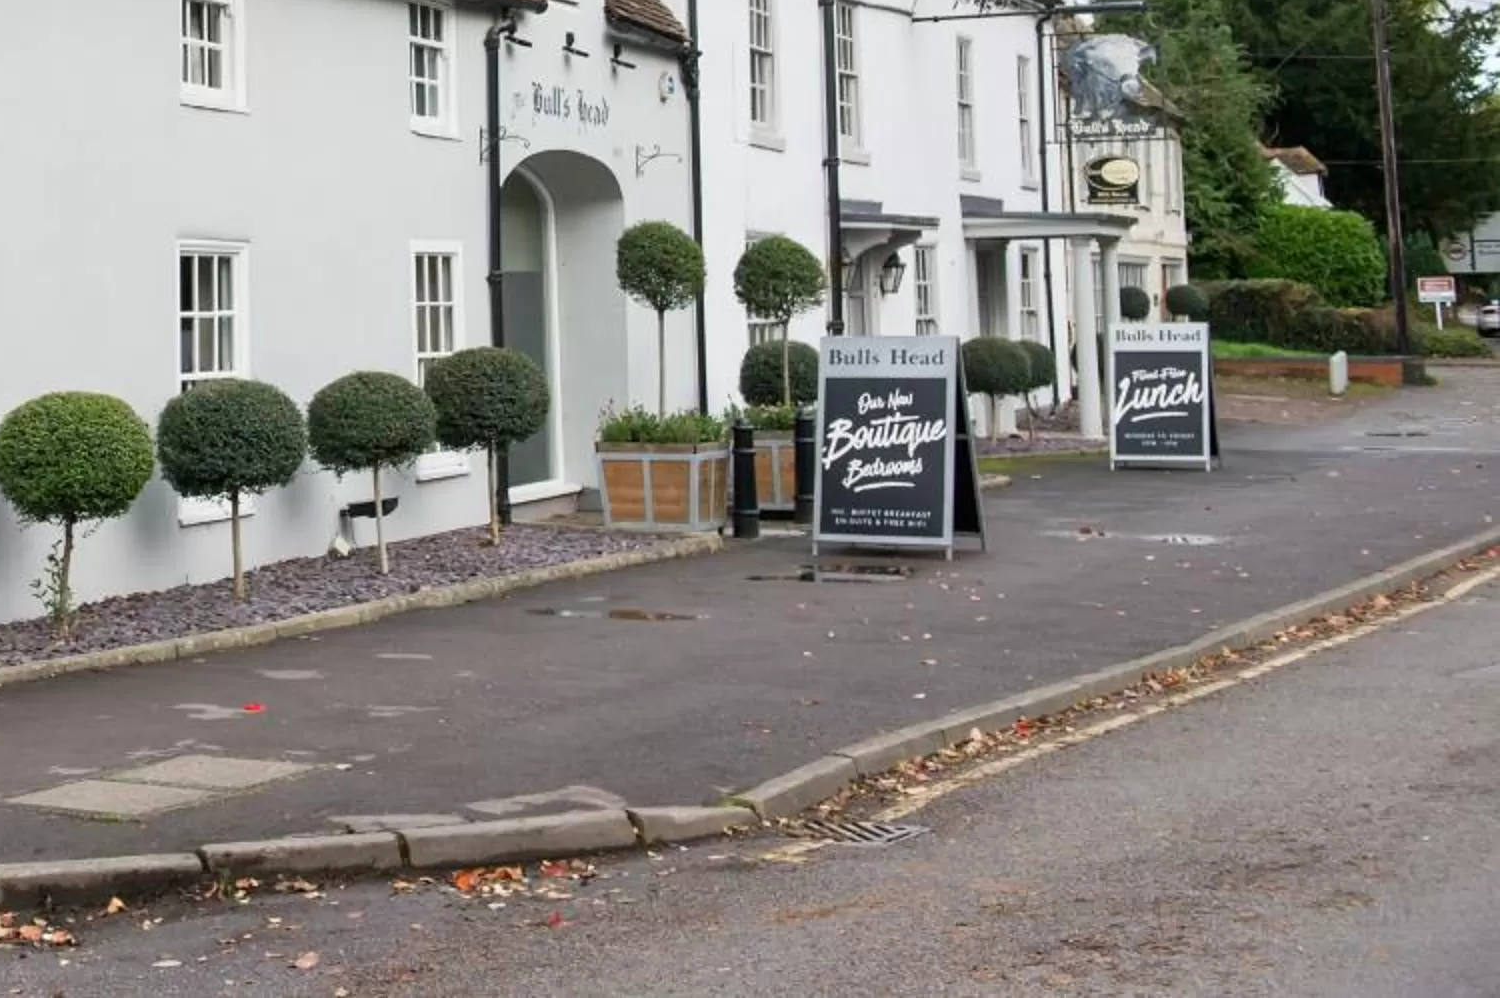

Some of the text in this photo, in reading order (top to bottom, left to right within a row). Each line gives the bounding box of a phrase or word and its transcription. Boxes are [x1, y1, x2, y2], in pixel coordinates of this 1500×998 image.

[1115, 329, 1202, 342] Bulls Head
[828, 349, 945, 366] Bulls Head
[857, 387, 913, 415] Our New
[1115, 372, 1204, 424] Lunch
[821, 413, 947, 470] Boutique
[842, 457, 924, 489] Bedrooms
